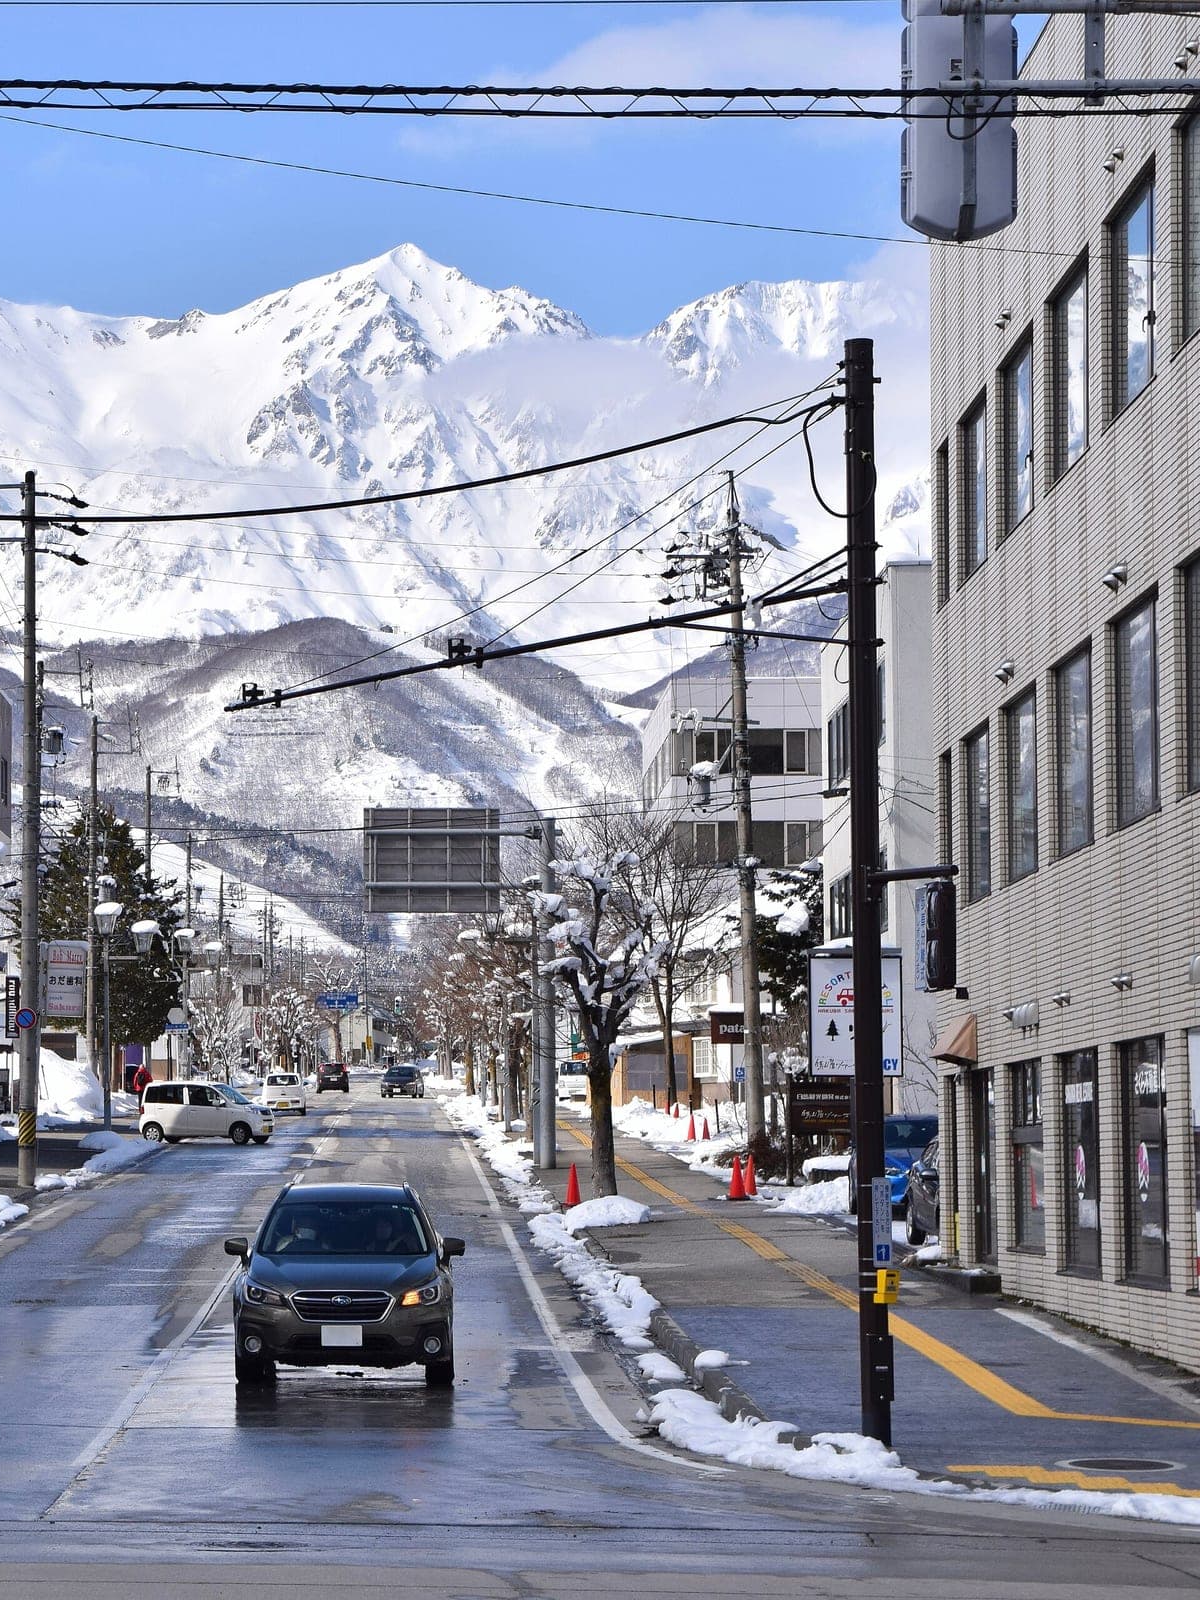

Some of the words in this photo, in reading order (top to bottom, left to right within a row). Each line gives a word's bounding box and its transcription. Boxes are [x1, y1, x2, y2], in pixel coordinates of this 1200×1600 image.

[48, 975, 83, 986] おだ歯科
[818, 971, 852, 1006] RESORT
